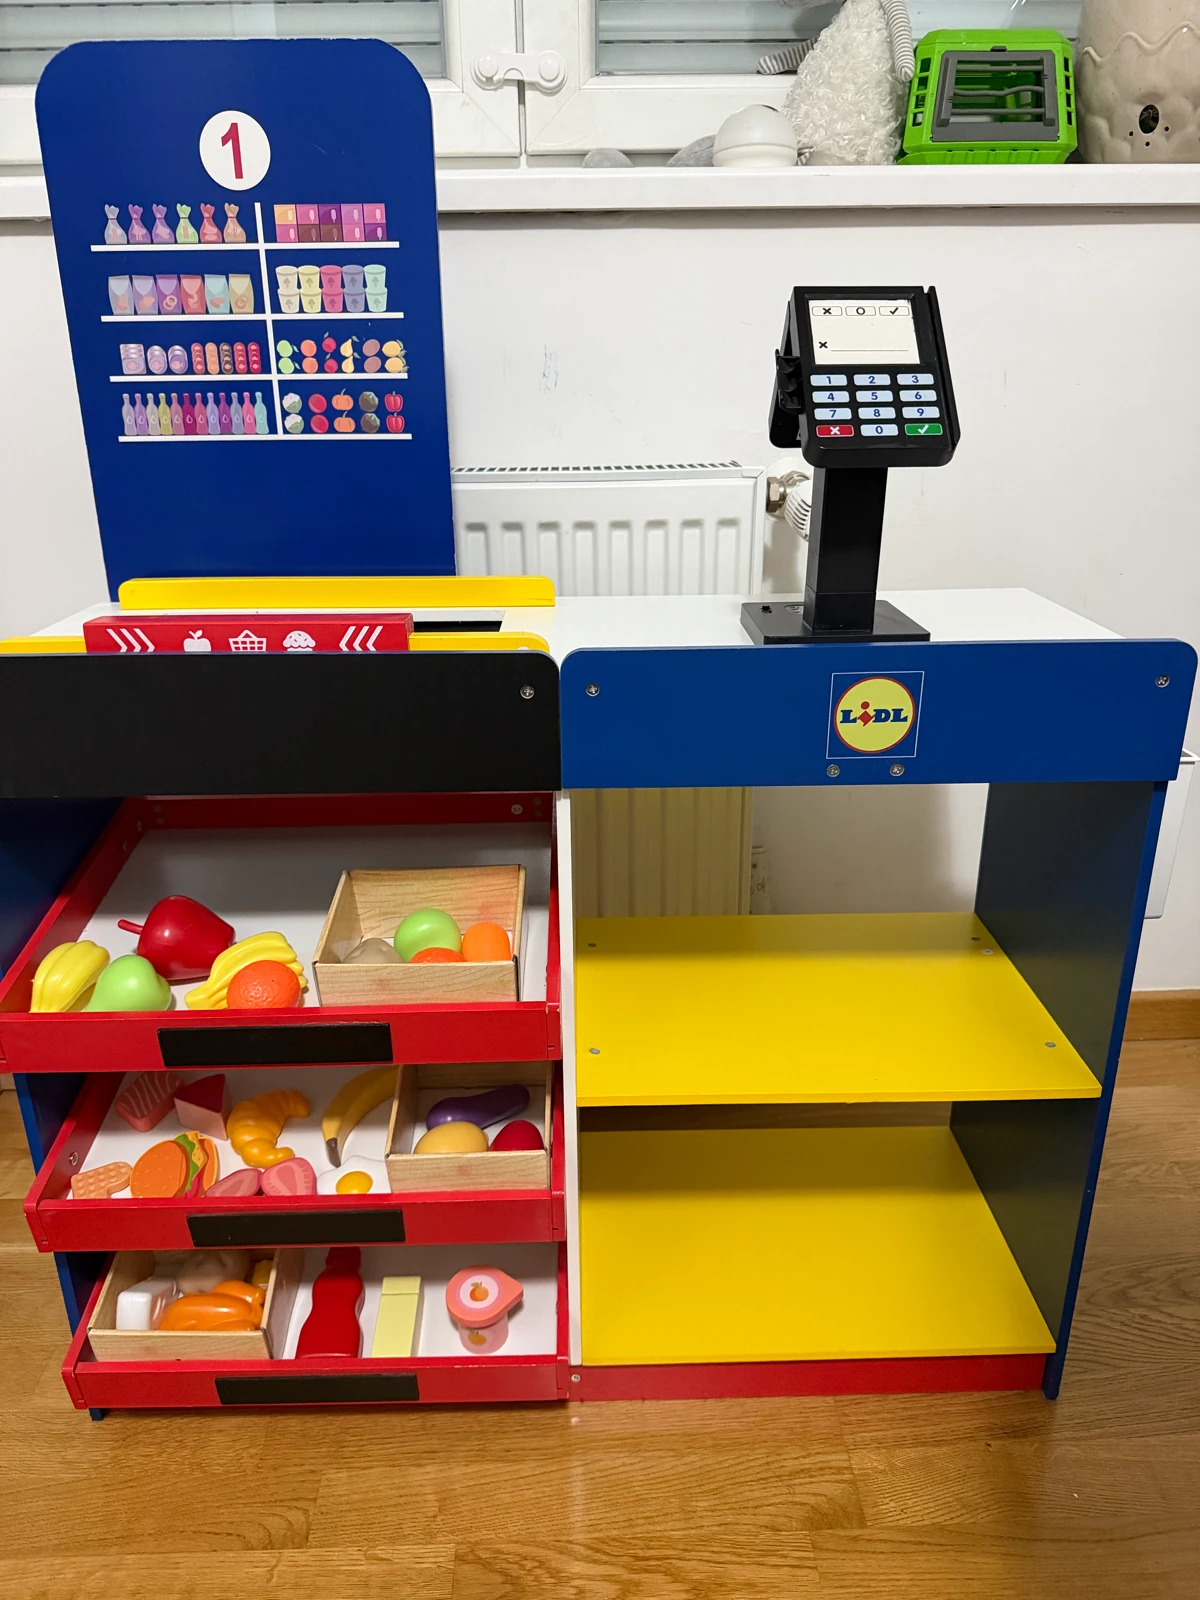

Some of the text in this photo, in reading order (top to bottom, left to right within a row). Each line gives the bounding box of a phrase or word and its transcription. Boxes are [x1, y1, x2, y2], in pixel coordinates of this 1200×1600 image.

[220, 122, 244, 179] 1
[826, 375, 919, 384] 1 2 3
[827, 391, 922, 401] 4 5 6
[829, 408, 924, 418] 7 8 9
[875, 425, 883, 435] 0
